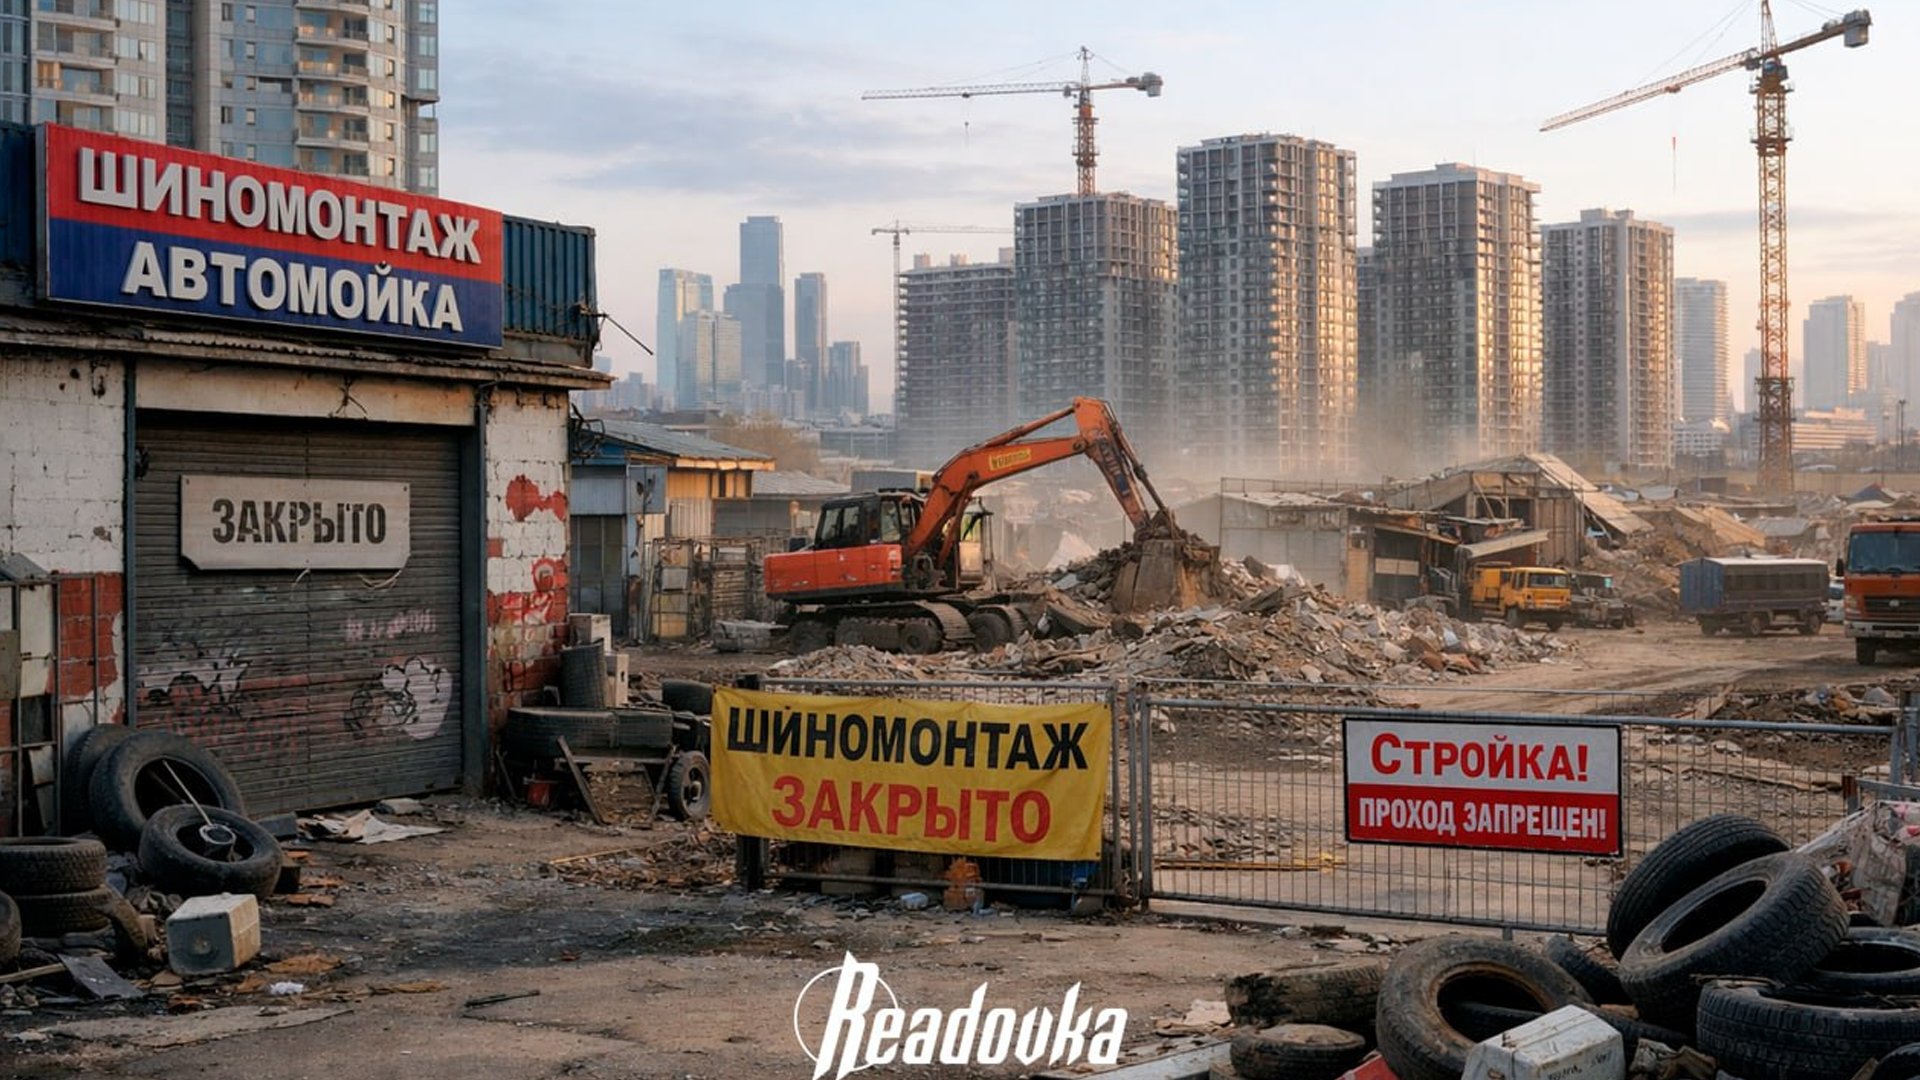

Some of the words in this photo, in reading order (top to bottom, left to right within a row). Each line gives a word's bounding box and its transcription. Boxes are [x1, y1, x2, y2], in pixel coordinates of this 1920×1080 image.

[79, 147, 481, 264] ШИНОМОНТАЖ
[122, 241, 464, 332] АВТОМОЙКА
[212, 498, 386, 544] ЗАКРЫТО
[772, 776, 1052, 844] ЗАКРЫТО
[1359, 797, 1457, 836] ПРОХОД
[1463, 801, 1607, 841] ЗАПРЕЩЕН!
